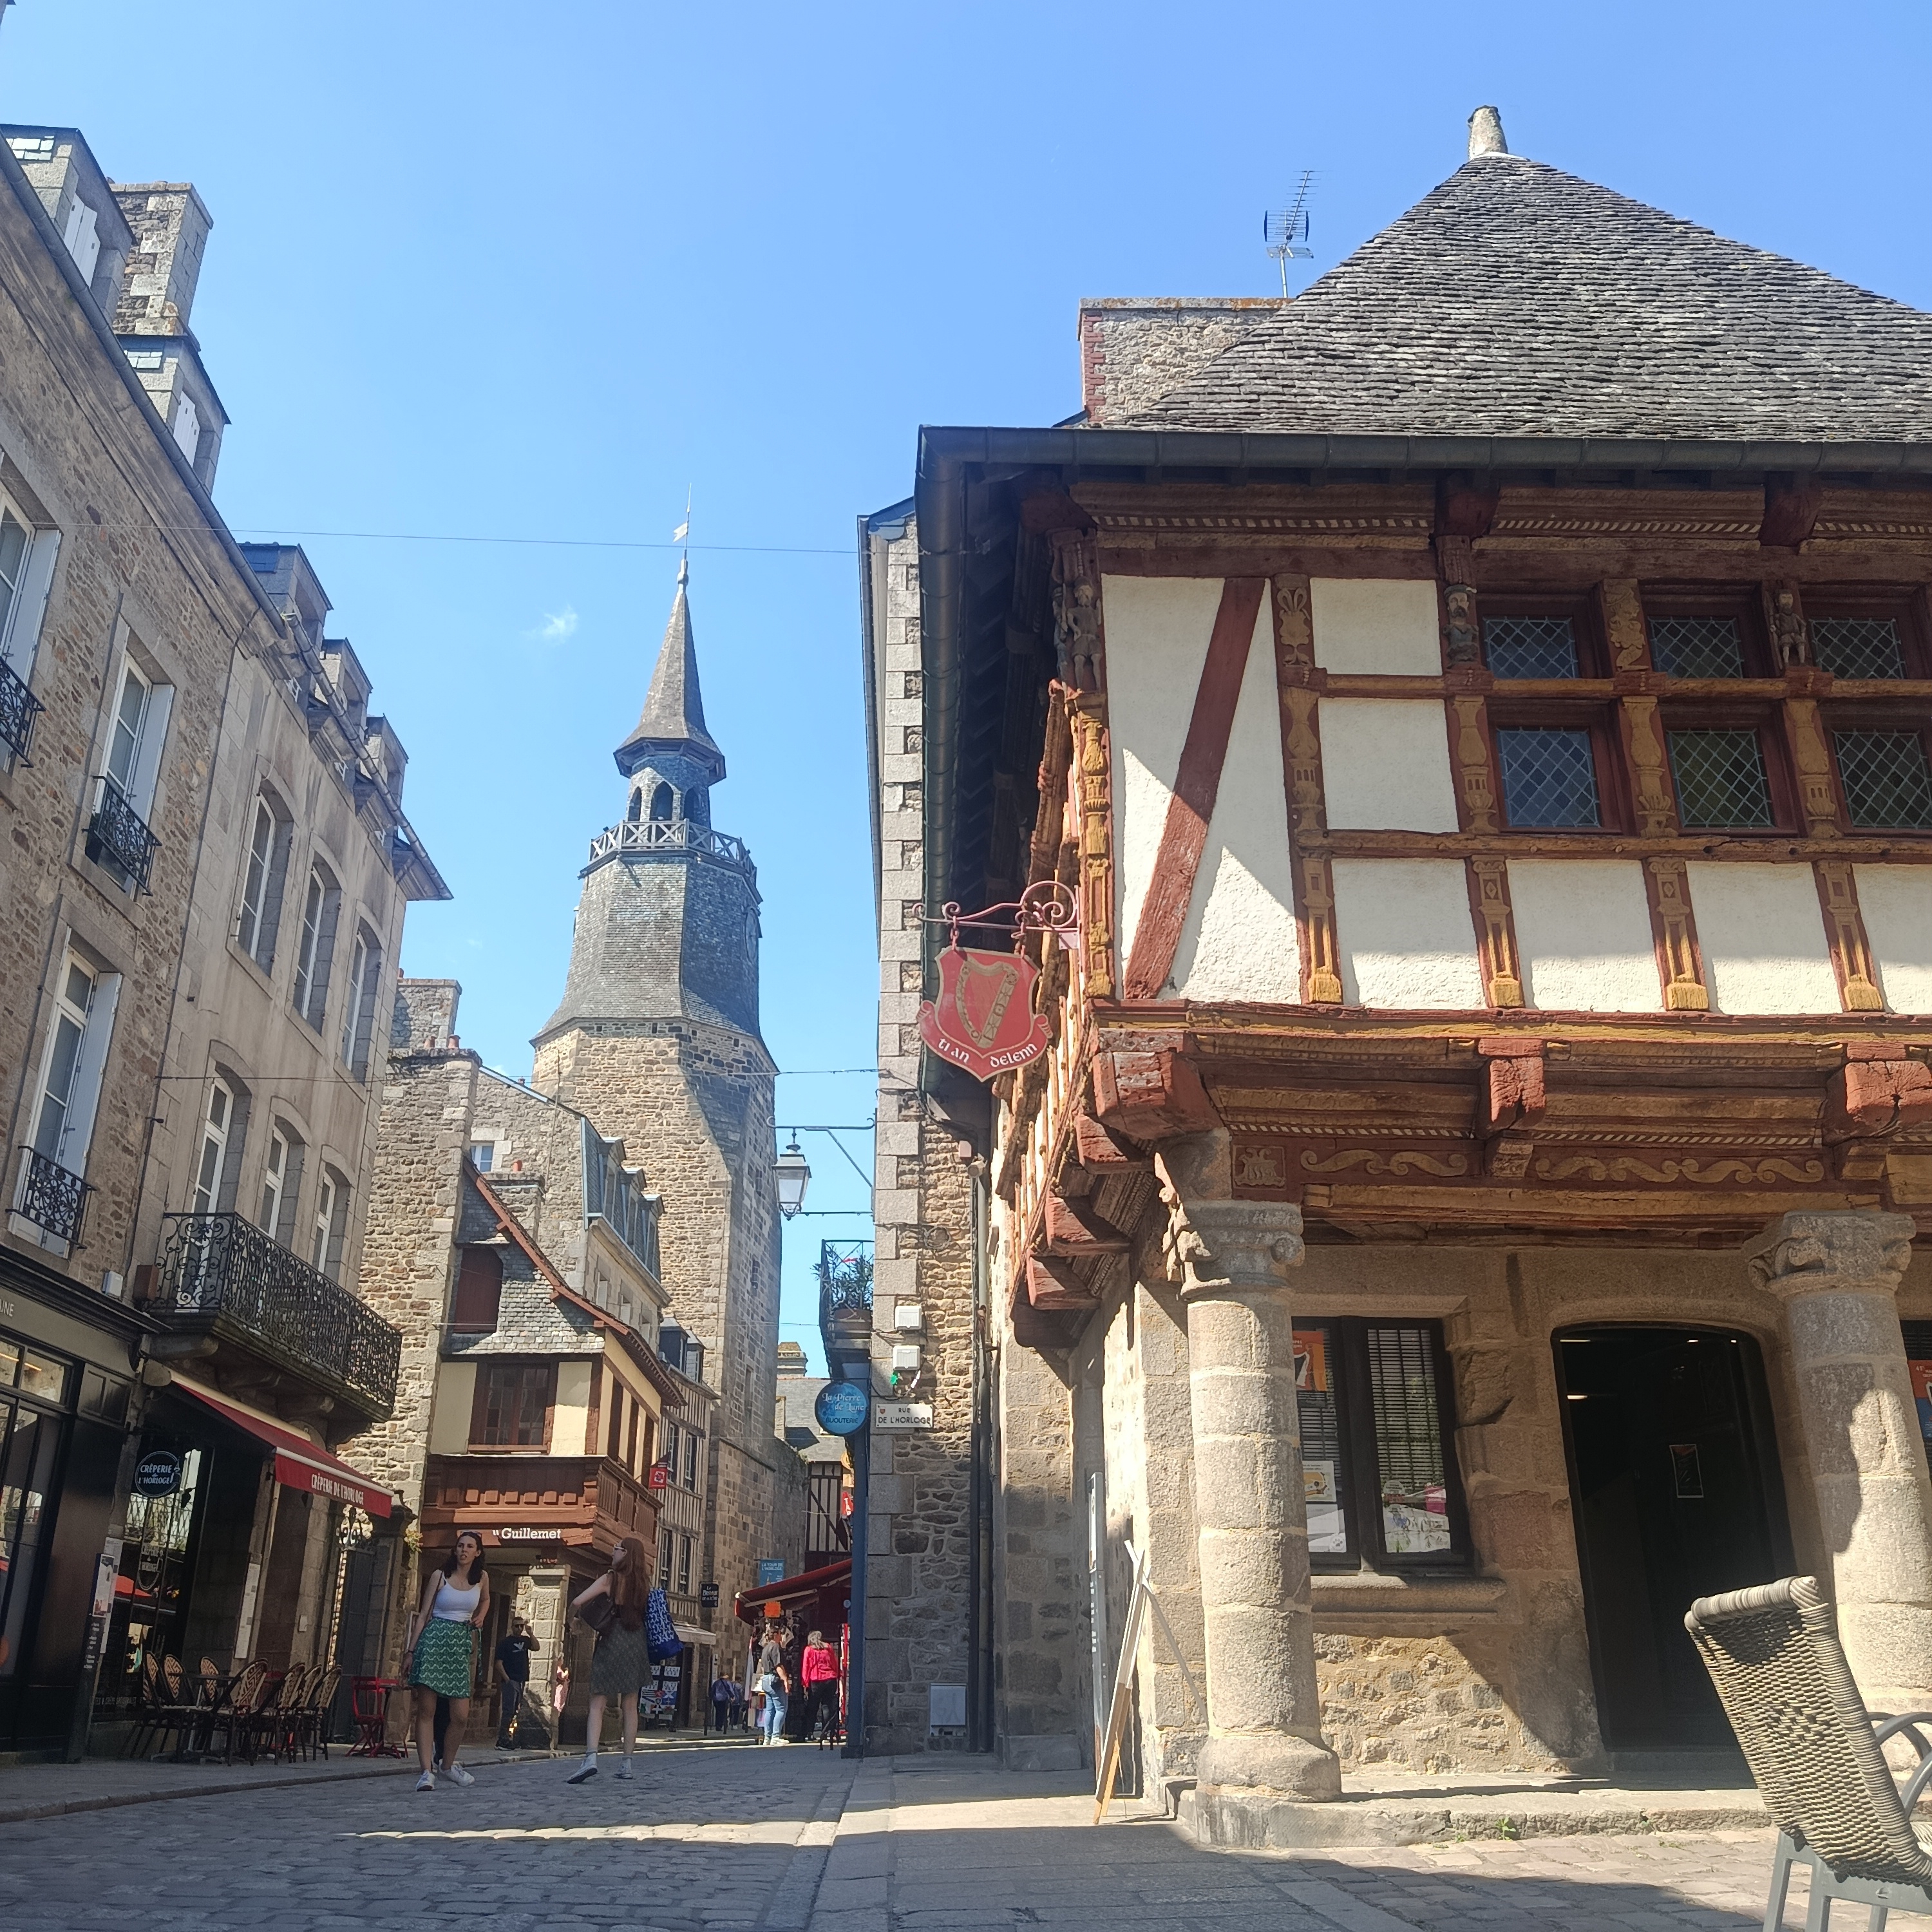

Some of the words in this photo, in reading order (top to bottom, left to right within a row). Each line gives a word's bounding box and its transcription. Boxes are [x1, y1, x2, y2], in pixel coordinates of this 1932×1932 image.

[951, 1048, 970, 1063] an
[990, 1043, 1038, 1068] delenn
[822, 1393, 833, 1404] La
[834, 1393, 861, 1401] Pierre
[834, 1402, 844, 1411] de
[844, 1403, 865, 1414] Lune
[890, 1416, 931, 1425] L'HORLOGE
[140, 1463, 173, 1473] CRÊPERIE
[311, 1472, 333, 1494] CRÊPERIE
[334, 1481, 340, 1497] DE
[341, 1484, 364, 1505] L'HORLOGE
